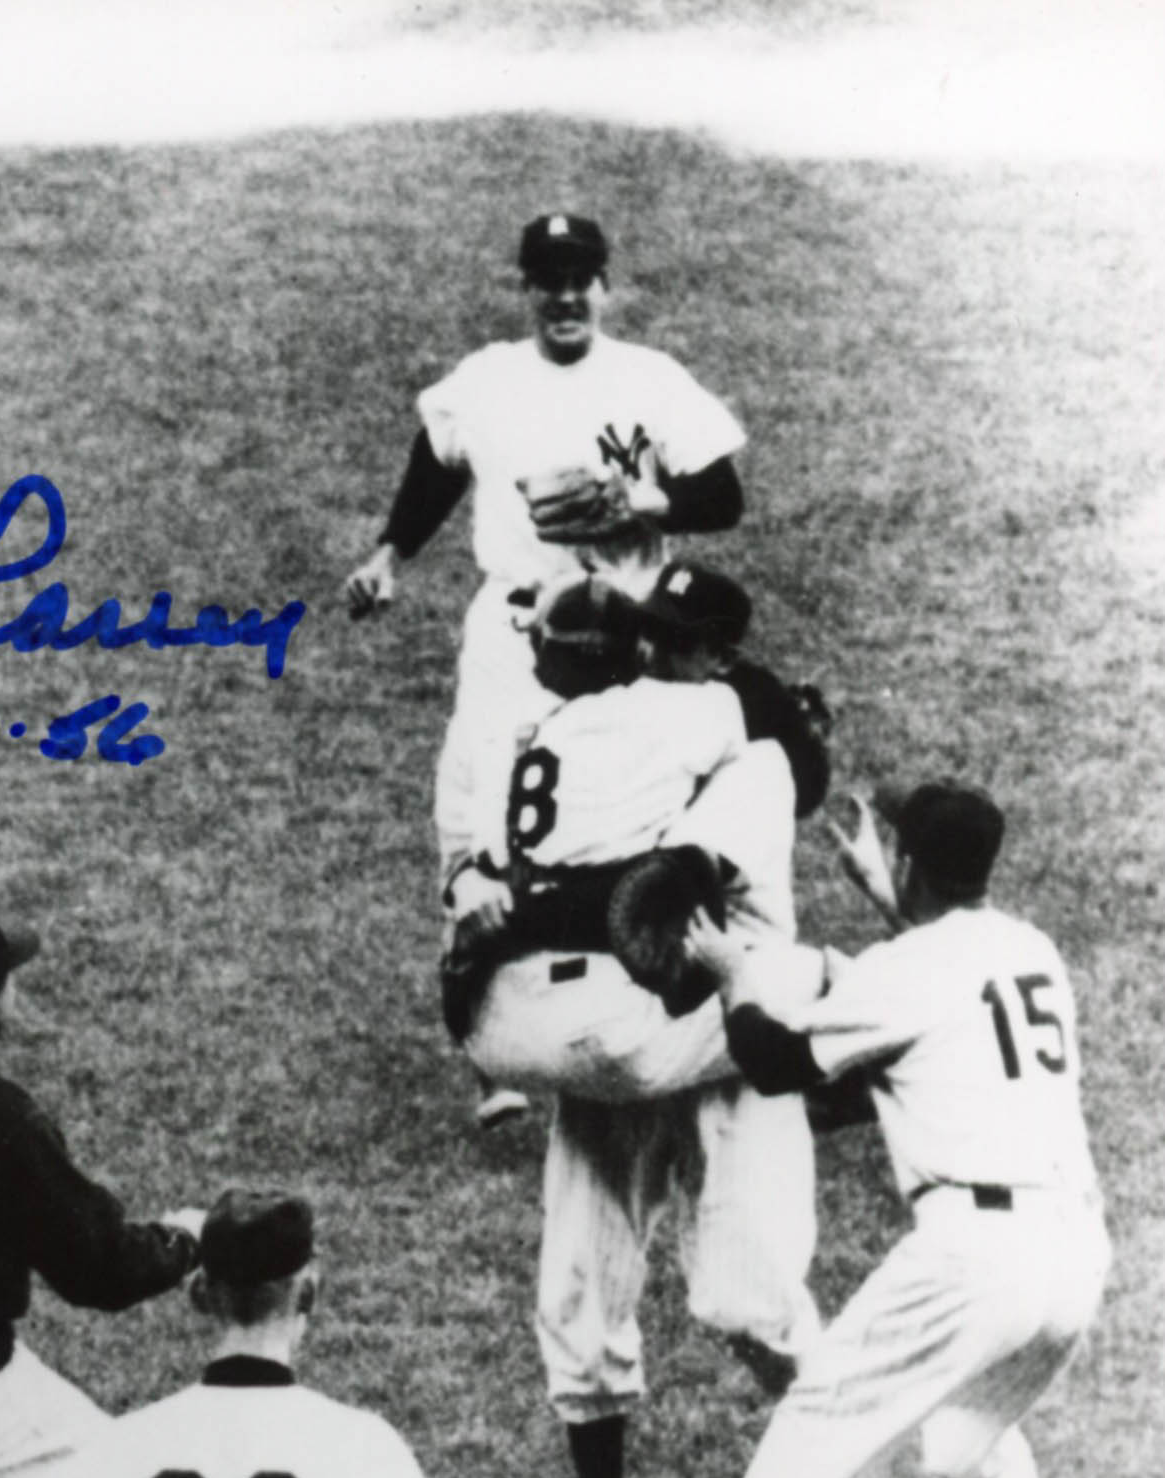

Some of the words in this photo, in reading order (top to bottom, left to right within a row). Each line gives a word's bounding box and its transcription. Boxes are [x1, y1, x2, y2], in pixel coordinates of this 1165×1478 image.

[596, 422, 651, 481] NY
[507, 746, 560, 850] 8
[981, 973, 1067, 1080] 15
